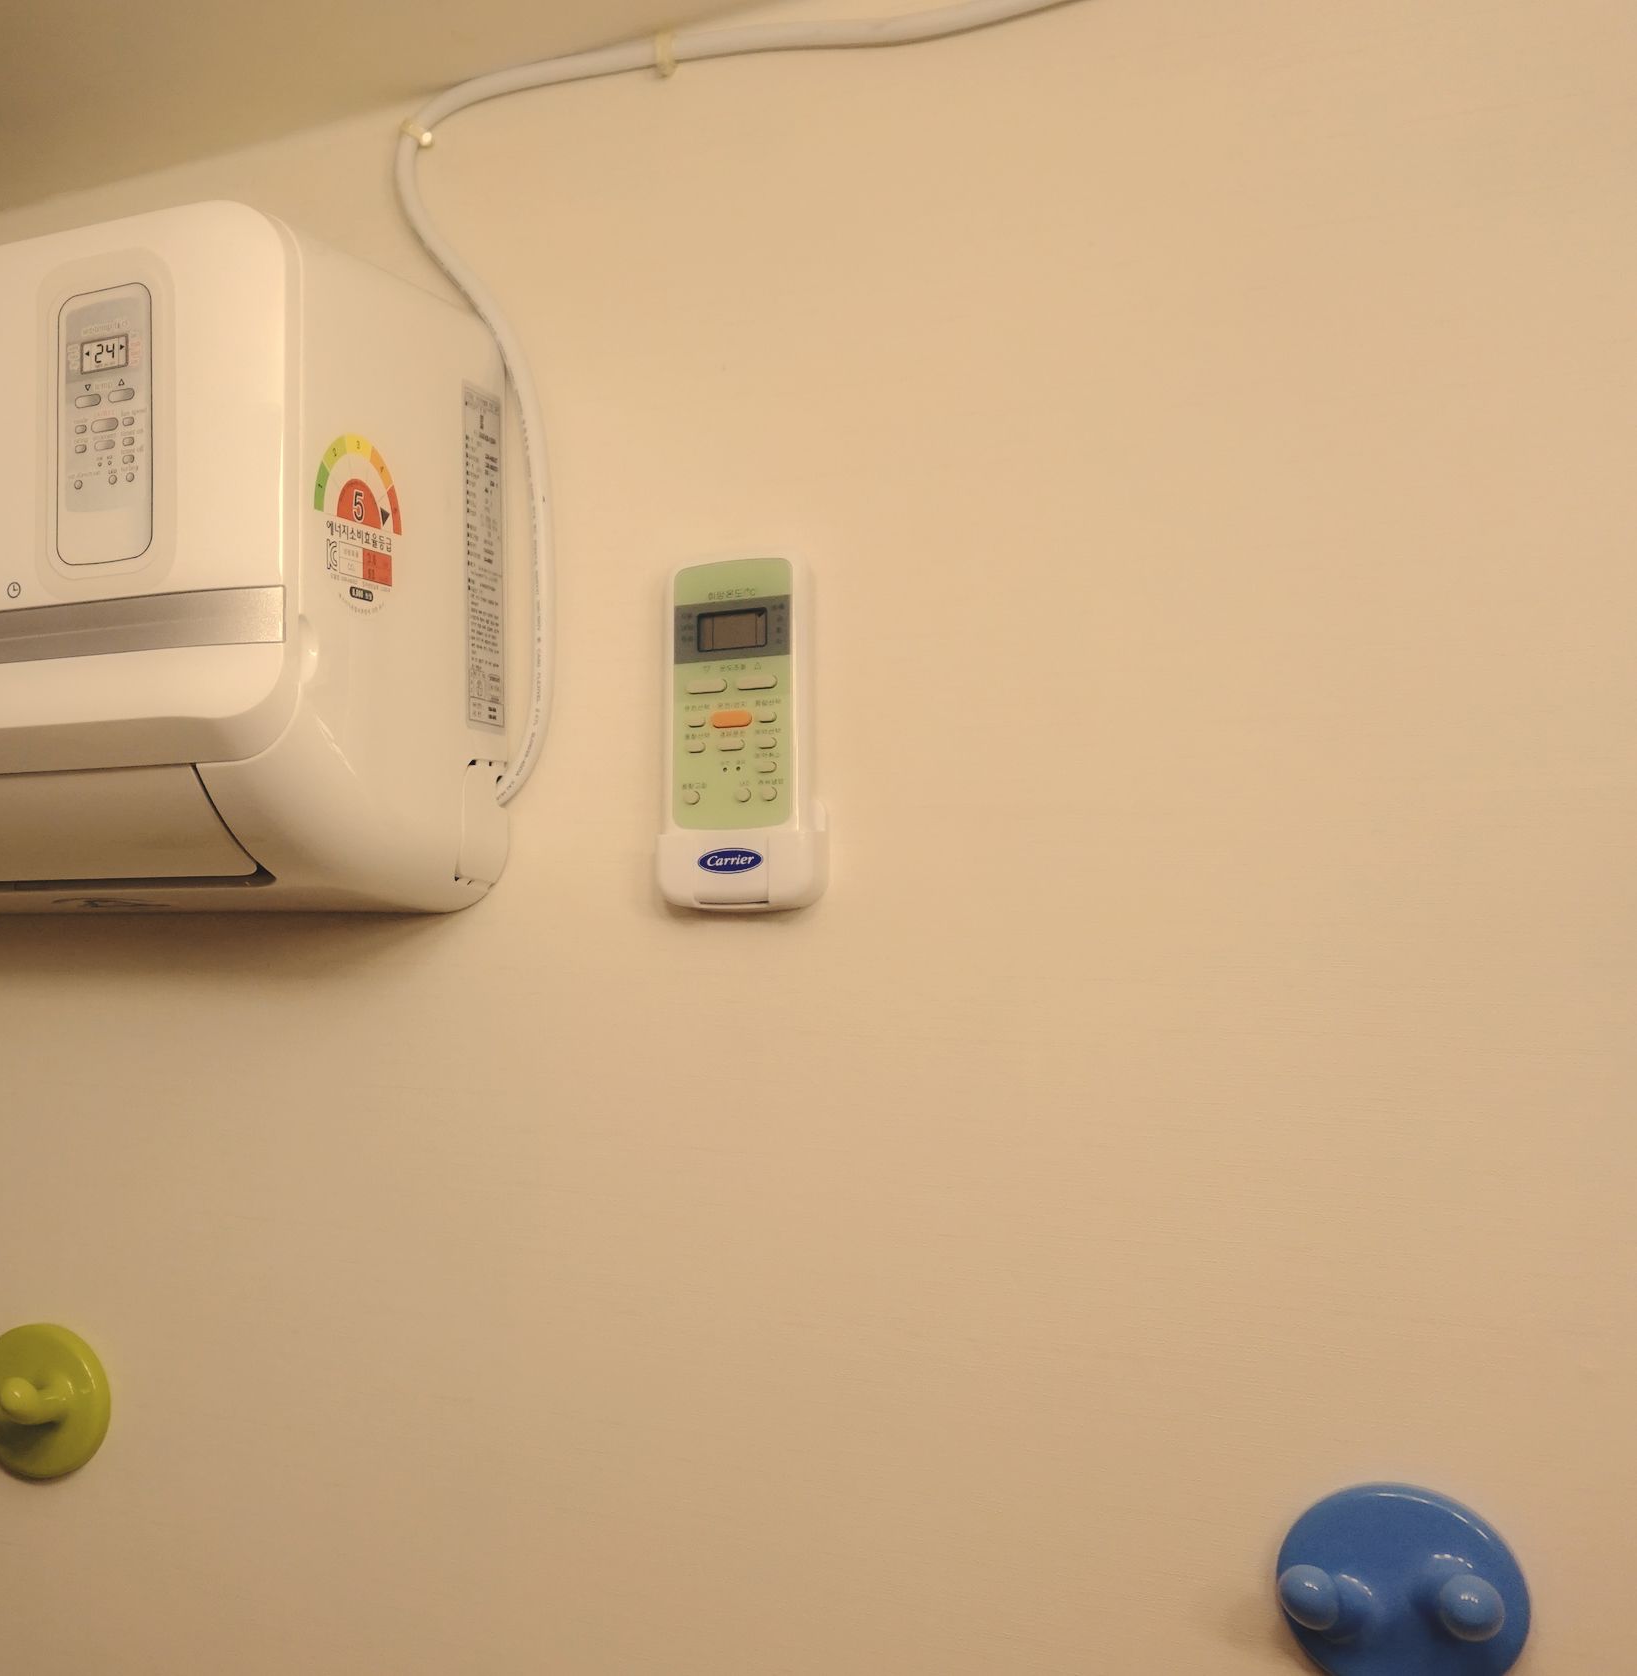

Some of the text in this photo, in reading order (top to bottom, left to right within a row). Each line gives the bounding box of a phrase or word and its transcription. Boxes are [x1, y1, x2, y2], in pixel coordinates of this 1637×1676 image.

[94, 343, 115, 364] 24
[352, 489, 365, 523] 5
[326, 520, 392, 553] 에너지소비효율등급
[706, 854, 755, 867] Carrier
